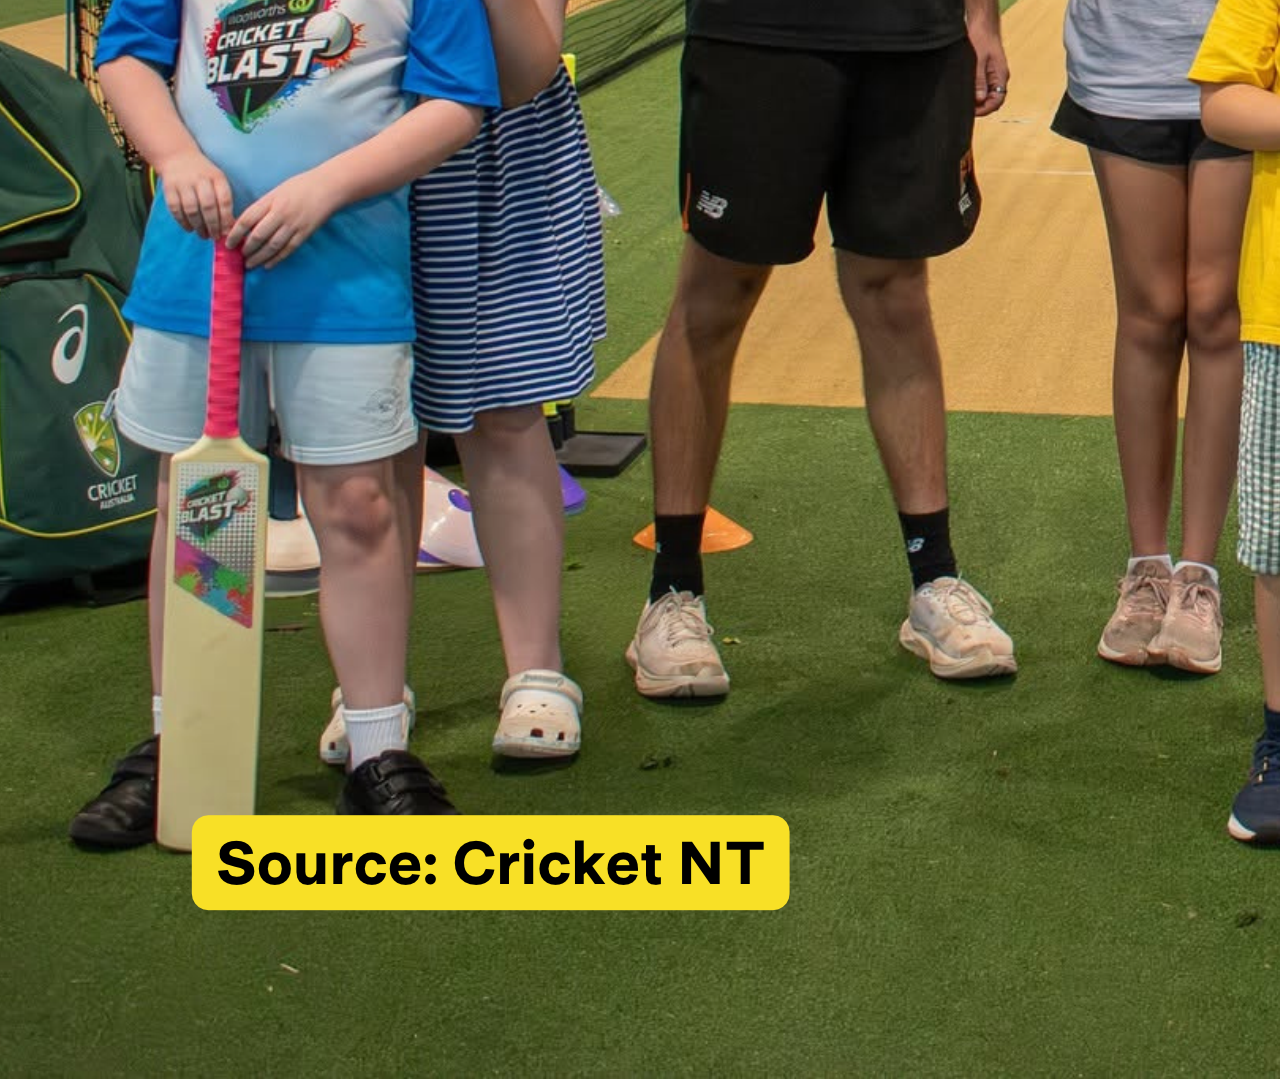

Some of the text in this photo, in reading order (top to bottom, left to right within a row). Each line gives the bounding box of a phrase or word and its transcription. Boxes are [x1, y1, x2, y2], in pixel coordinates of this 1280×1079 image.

[216, 17, 306, 52] CRICKET
[206, 39, 329, 85] BLAST
[87, 474, 138, 501] CRICKET
